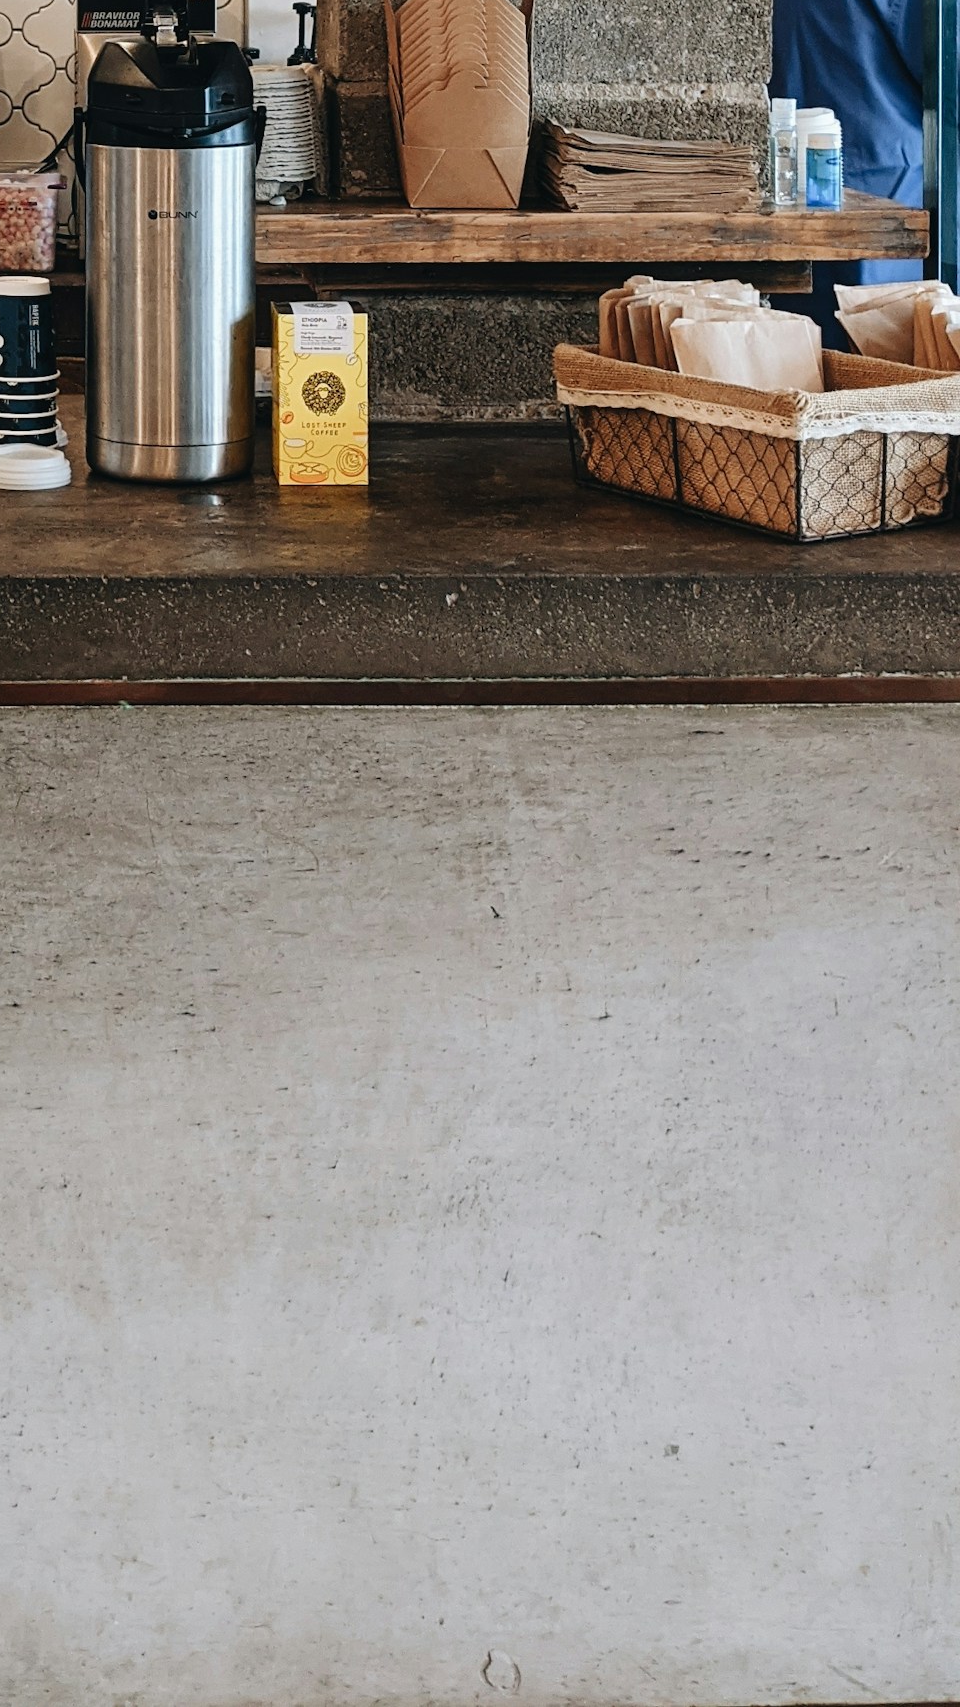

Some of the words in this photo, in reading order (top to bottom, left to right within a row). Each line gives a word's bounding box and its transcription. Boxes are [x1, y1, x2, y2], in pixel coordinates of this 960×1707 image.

[92, 11, 140, 20] BRAVILOR
[90, 19, 140, 28] BONAMAT
[159, 211, 198, 219] BUNN
[301, 421, 321, 429] LOST
[323, 421, 347, 429] SHEEP
